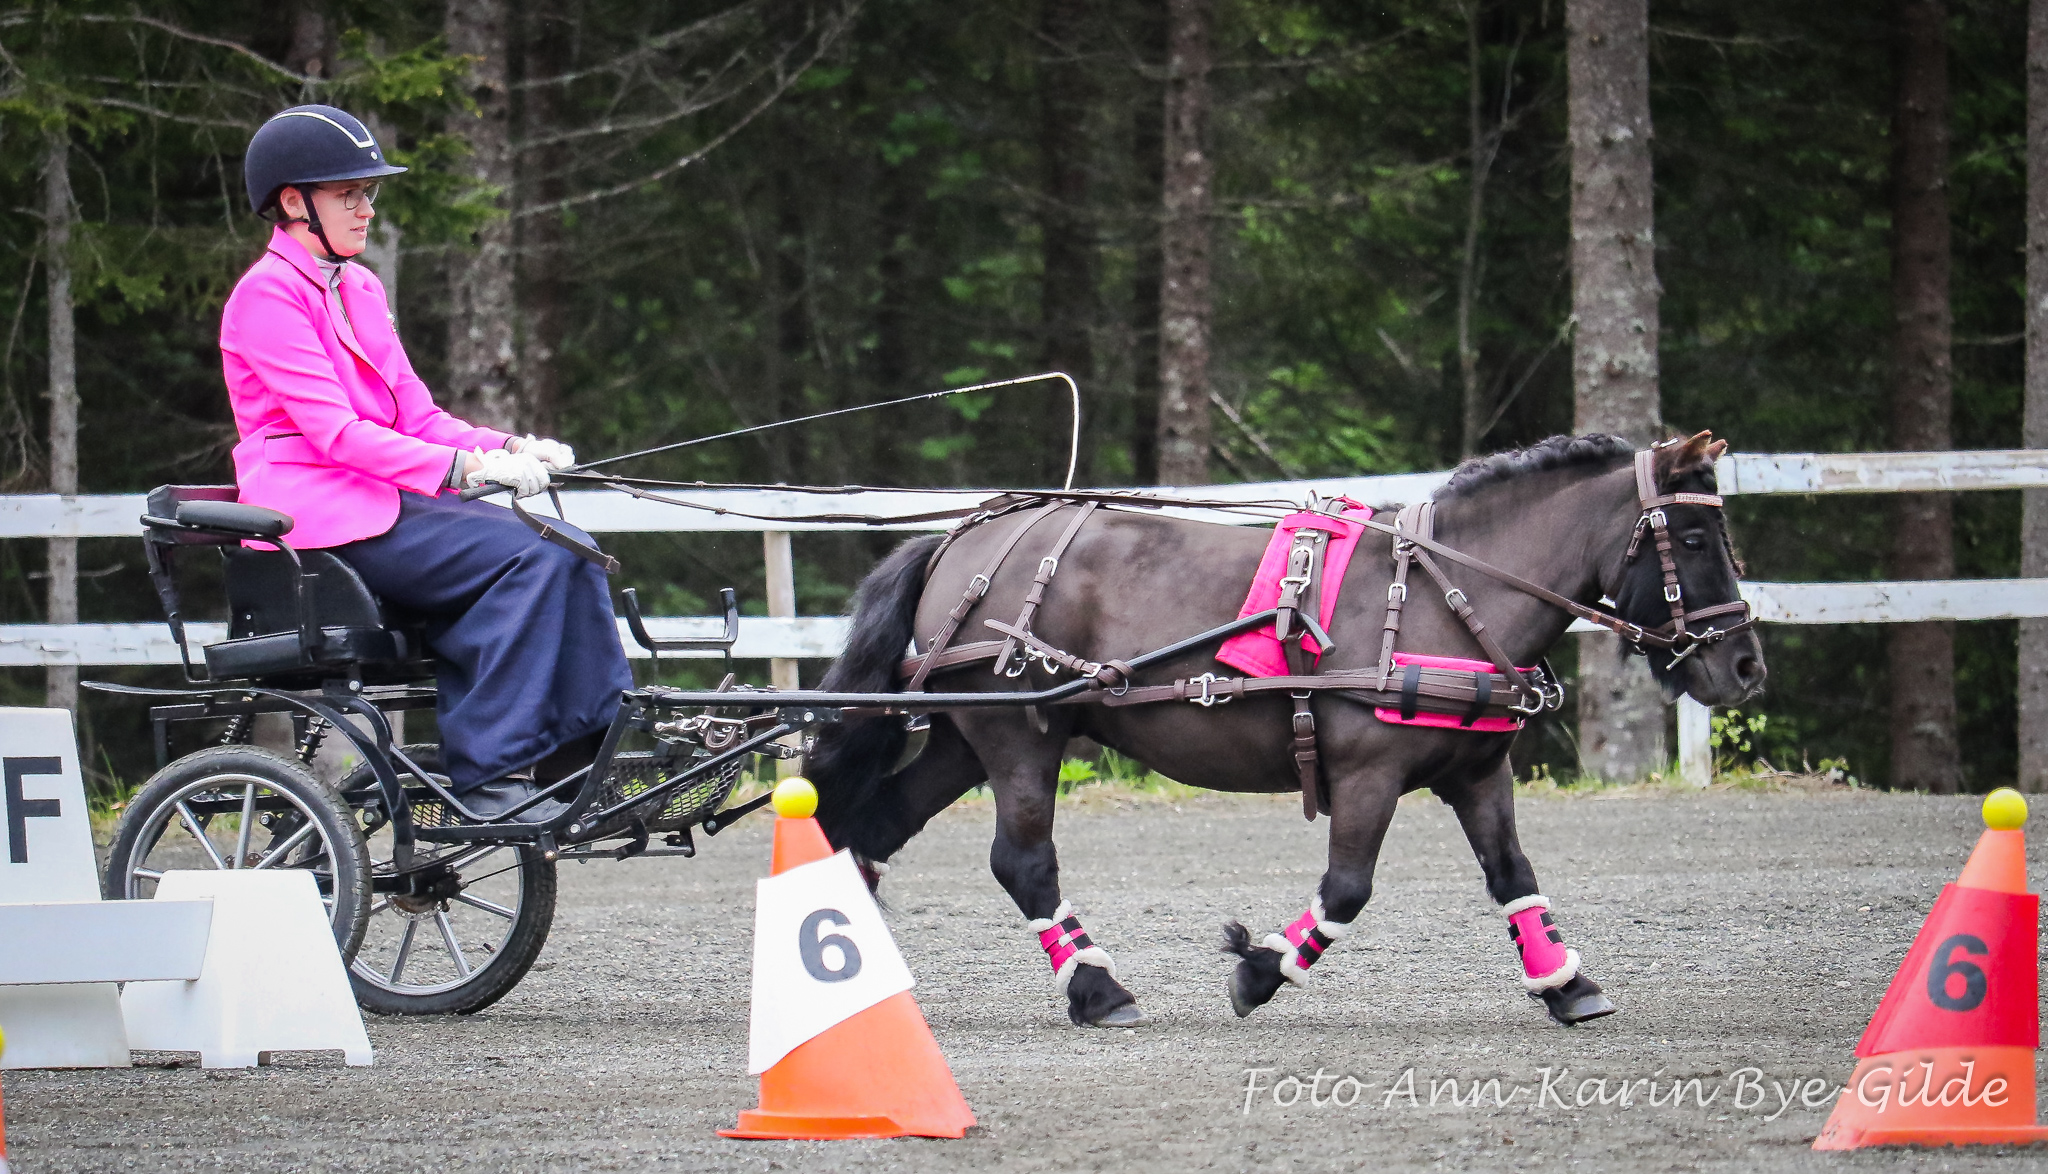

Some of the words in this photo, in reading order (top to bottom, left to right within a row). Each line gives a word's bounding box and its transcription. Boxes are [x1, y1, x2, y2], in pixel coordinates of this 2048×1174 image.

[3, 756, 62, 863] F
[799, 908, 862, 983] 6
[1927, 934, 1989, 1012] 6
